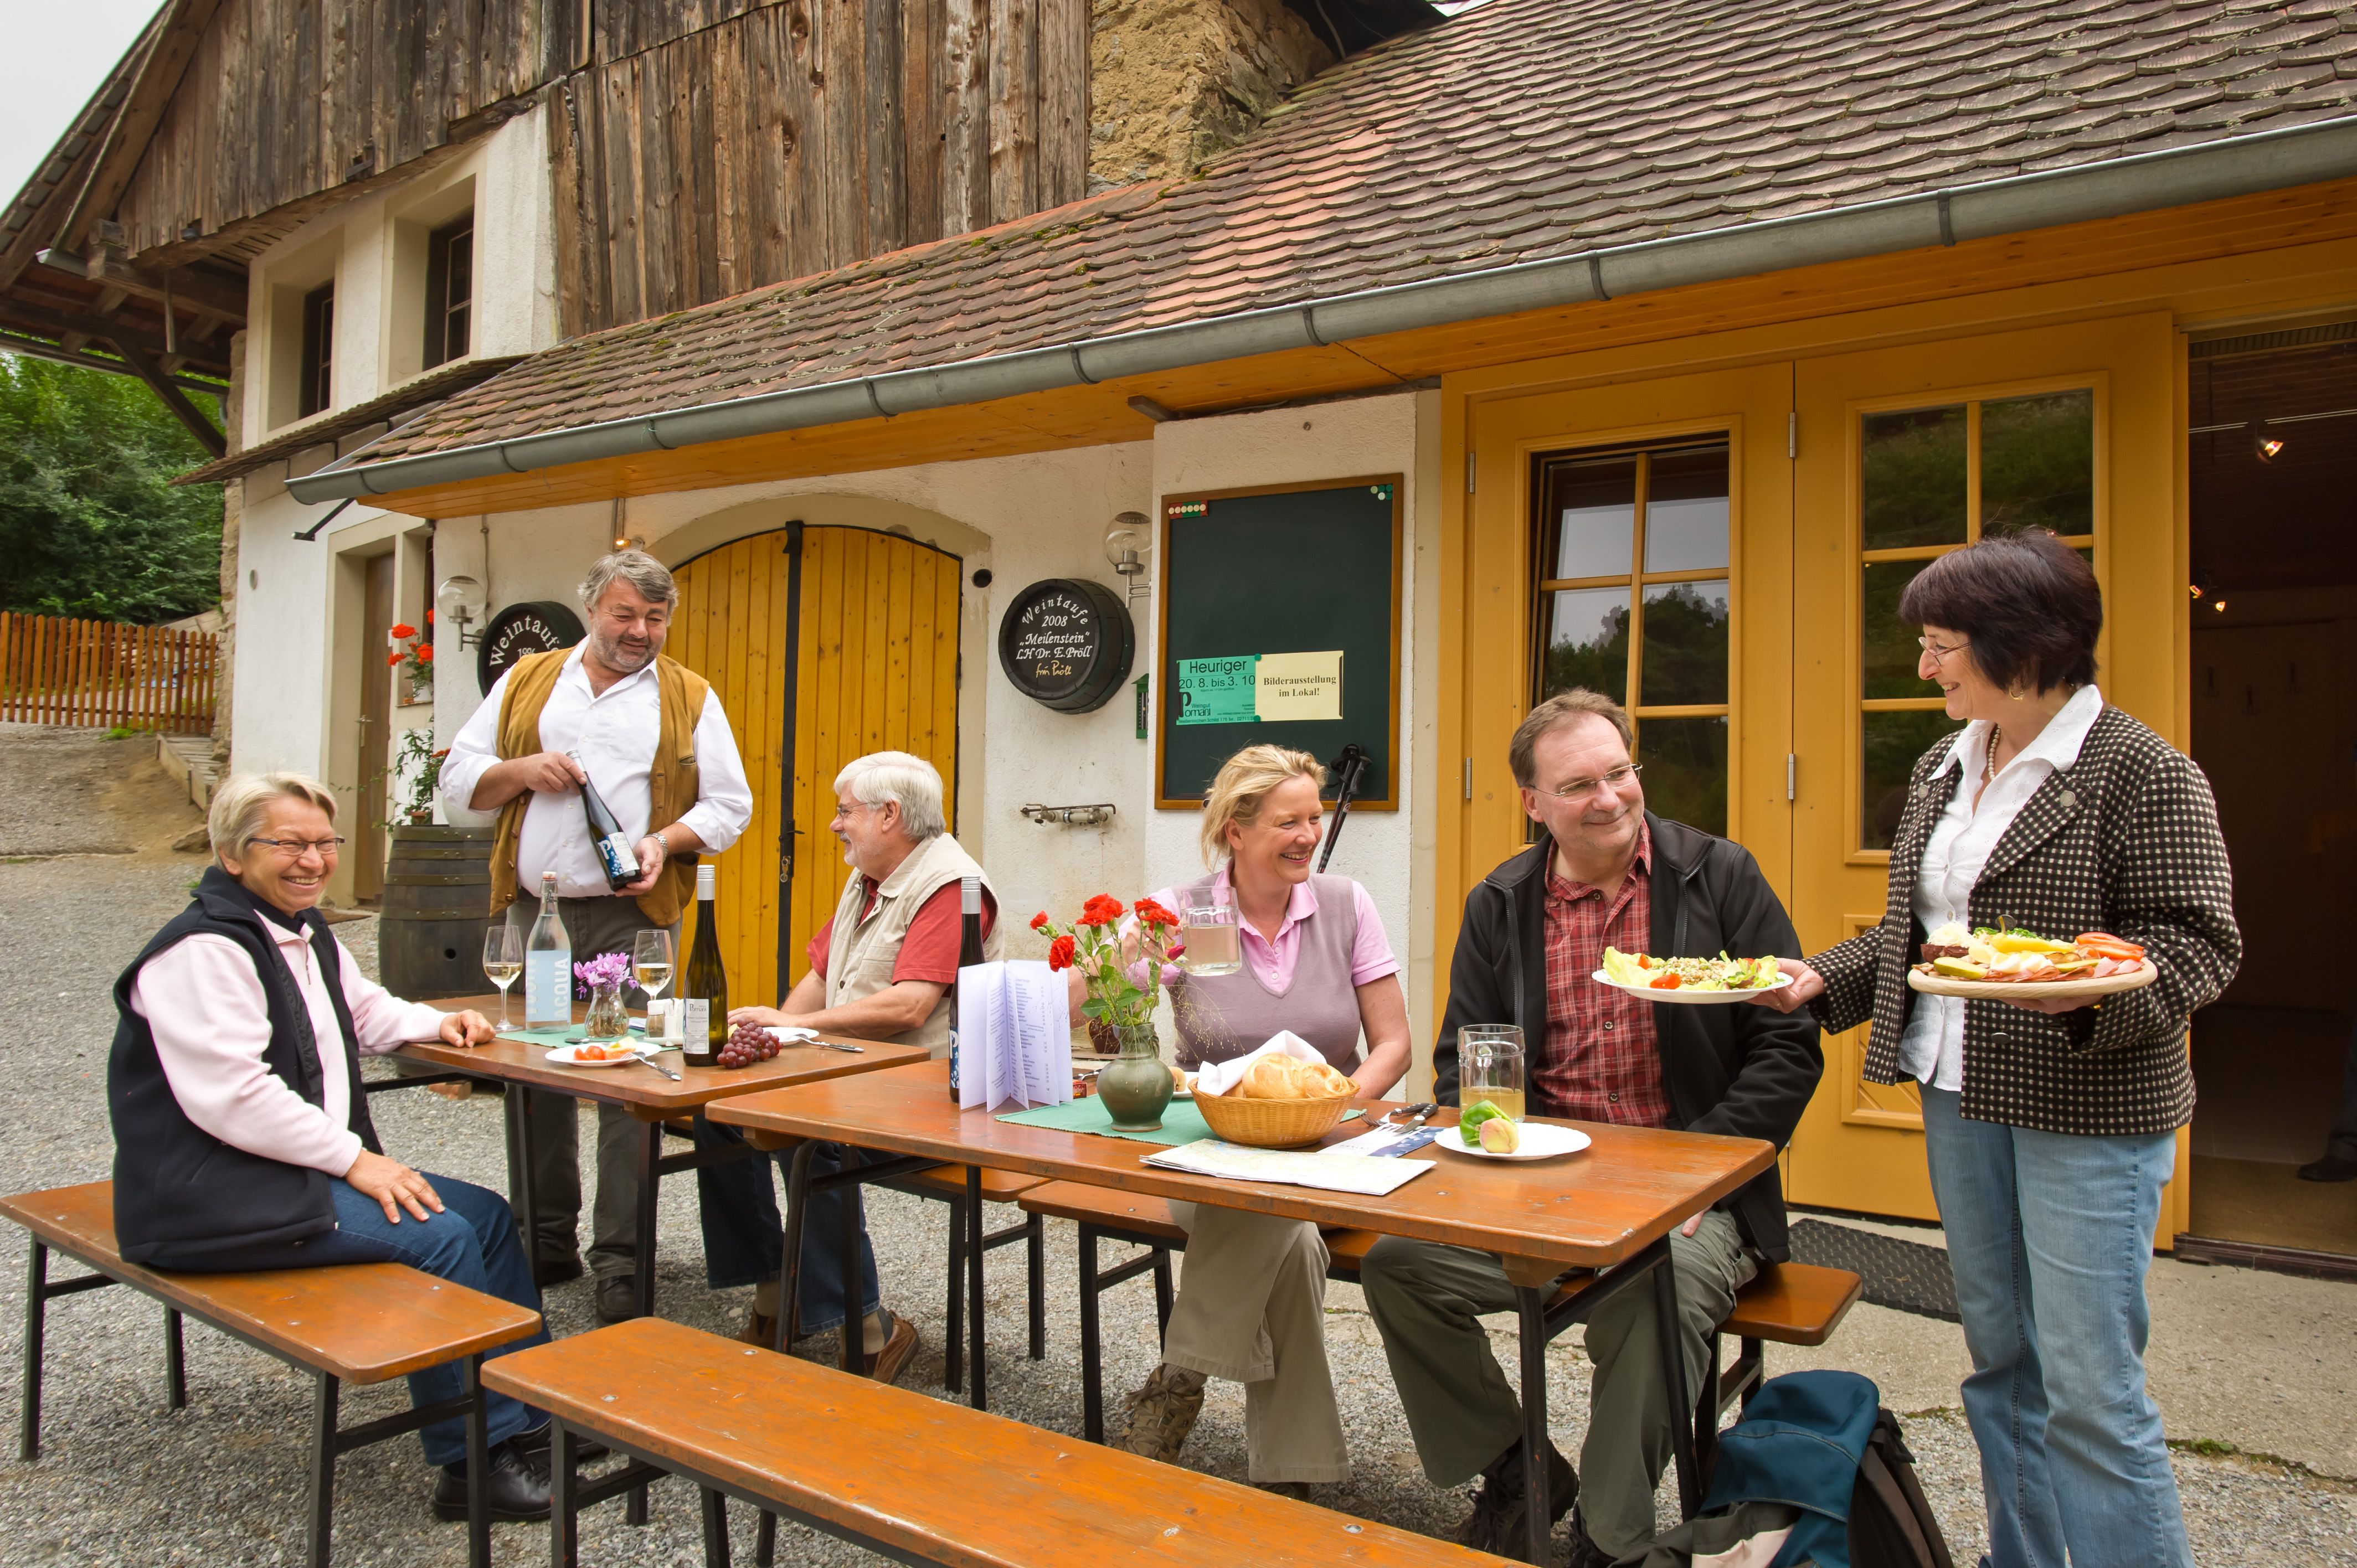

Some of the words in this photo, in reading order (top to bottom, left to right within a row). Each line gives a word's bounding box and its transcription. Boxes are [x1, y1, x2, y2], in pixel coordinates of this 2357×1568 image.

[1022, 594, 1088, 625] Weintaufe
[1041, 615, 1068, 627] 2008
[1016, 649, 1035, 660] LH
[1036, 648, 1051, 659] Dr.
[1190, 659, 1247, 675] Heuriger
[1179, 679, 1196, 689] 20.
[1198, 678, 1208, 688] 8.
[1211, 678, 1225, 687] bis
[1227, 676, 1238, 686] 3.
[1263, 675, 1336, 686] Bilderausstellung
[1279, 689, 1290, 698] im
[1292, 688, 1320, 697] Lokal!
[554, 957, 569, 1018] ACQUA
